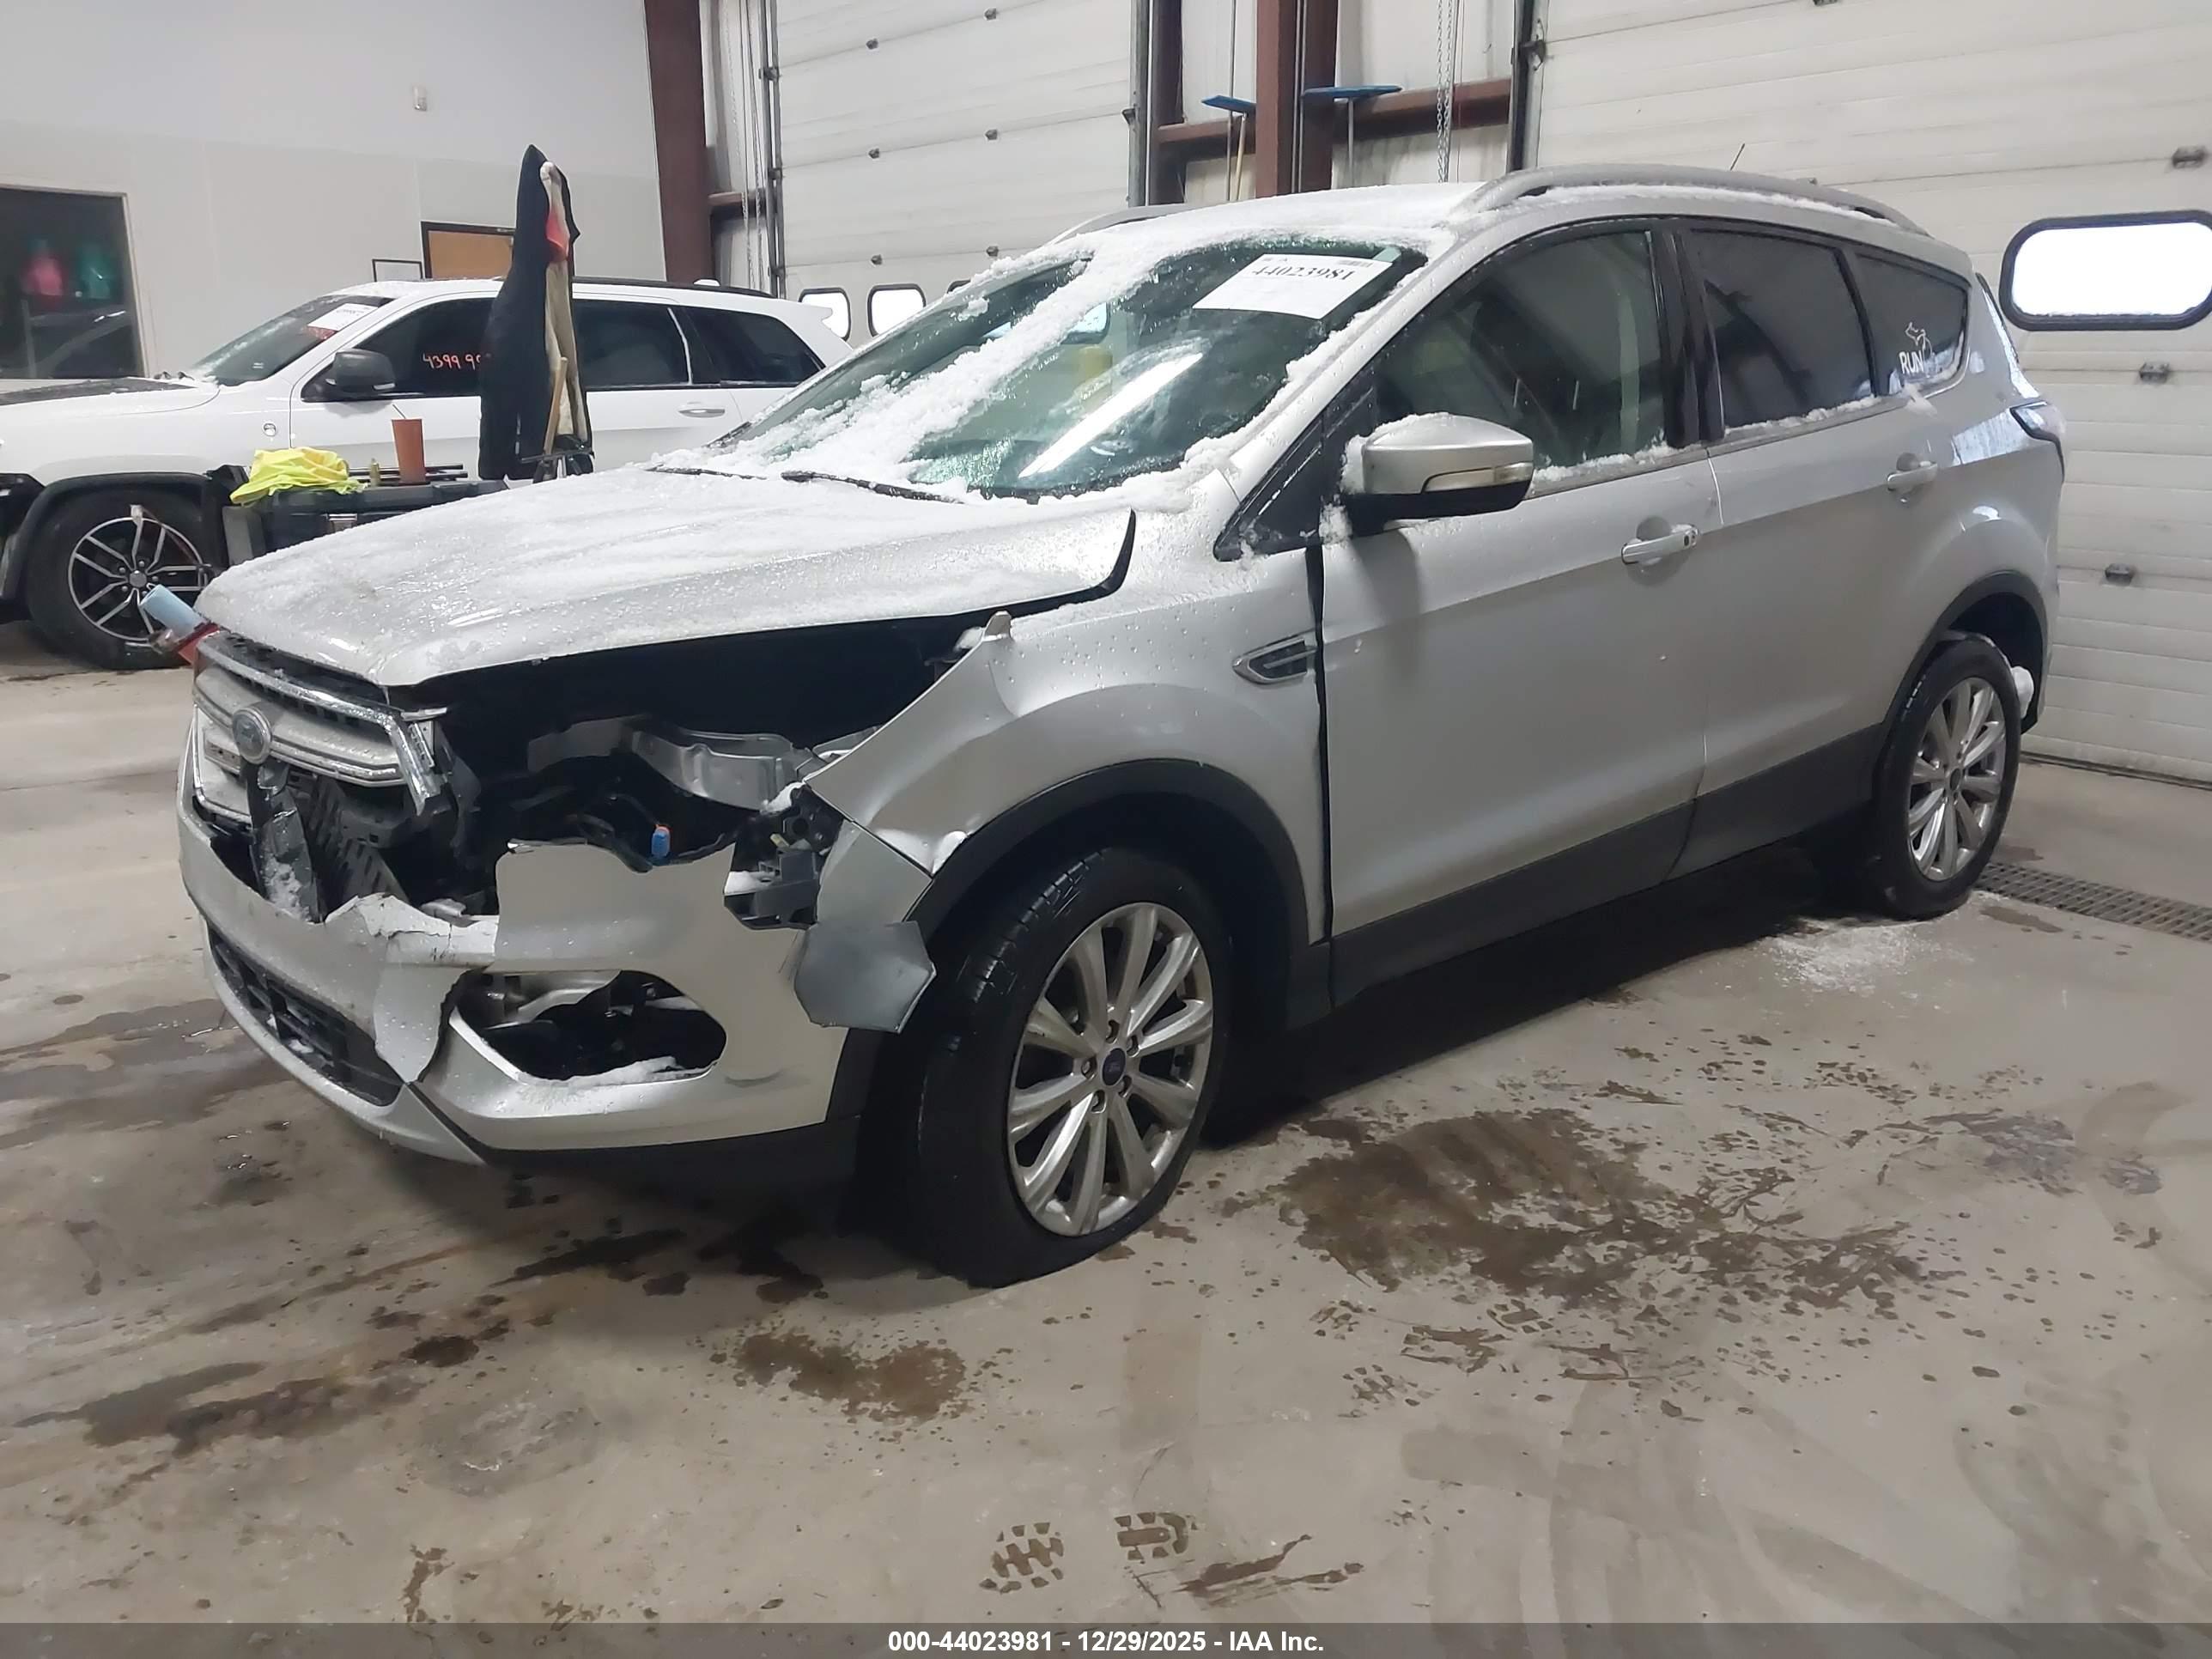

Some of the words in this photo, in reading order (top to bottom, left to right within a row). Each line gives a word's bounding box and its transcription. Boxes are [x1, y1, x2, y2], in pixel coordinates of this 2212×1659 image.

[1251, 265, 1356, 281] 44023981
[422, 352, 461, 370] 4399
[1899, 349, 1924, 374] RUN
